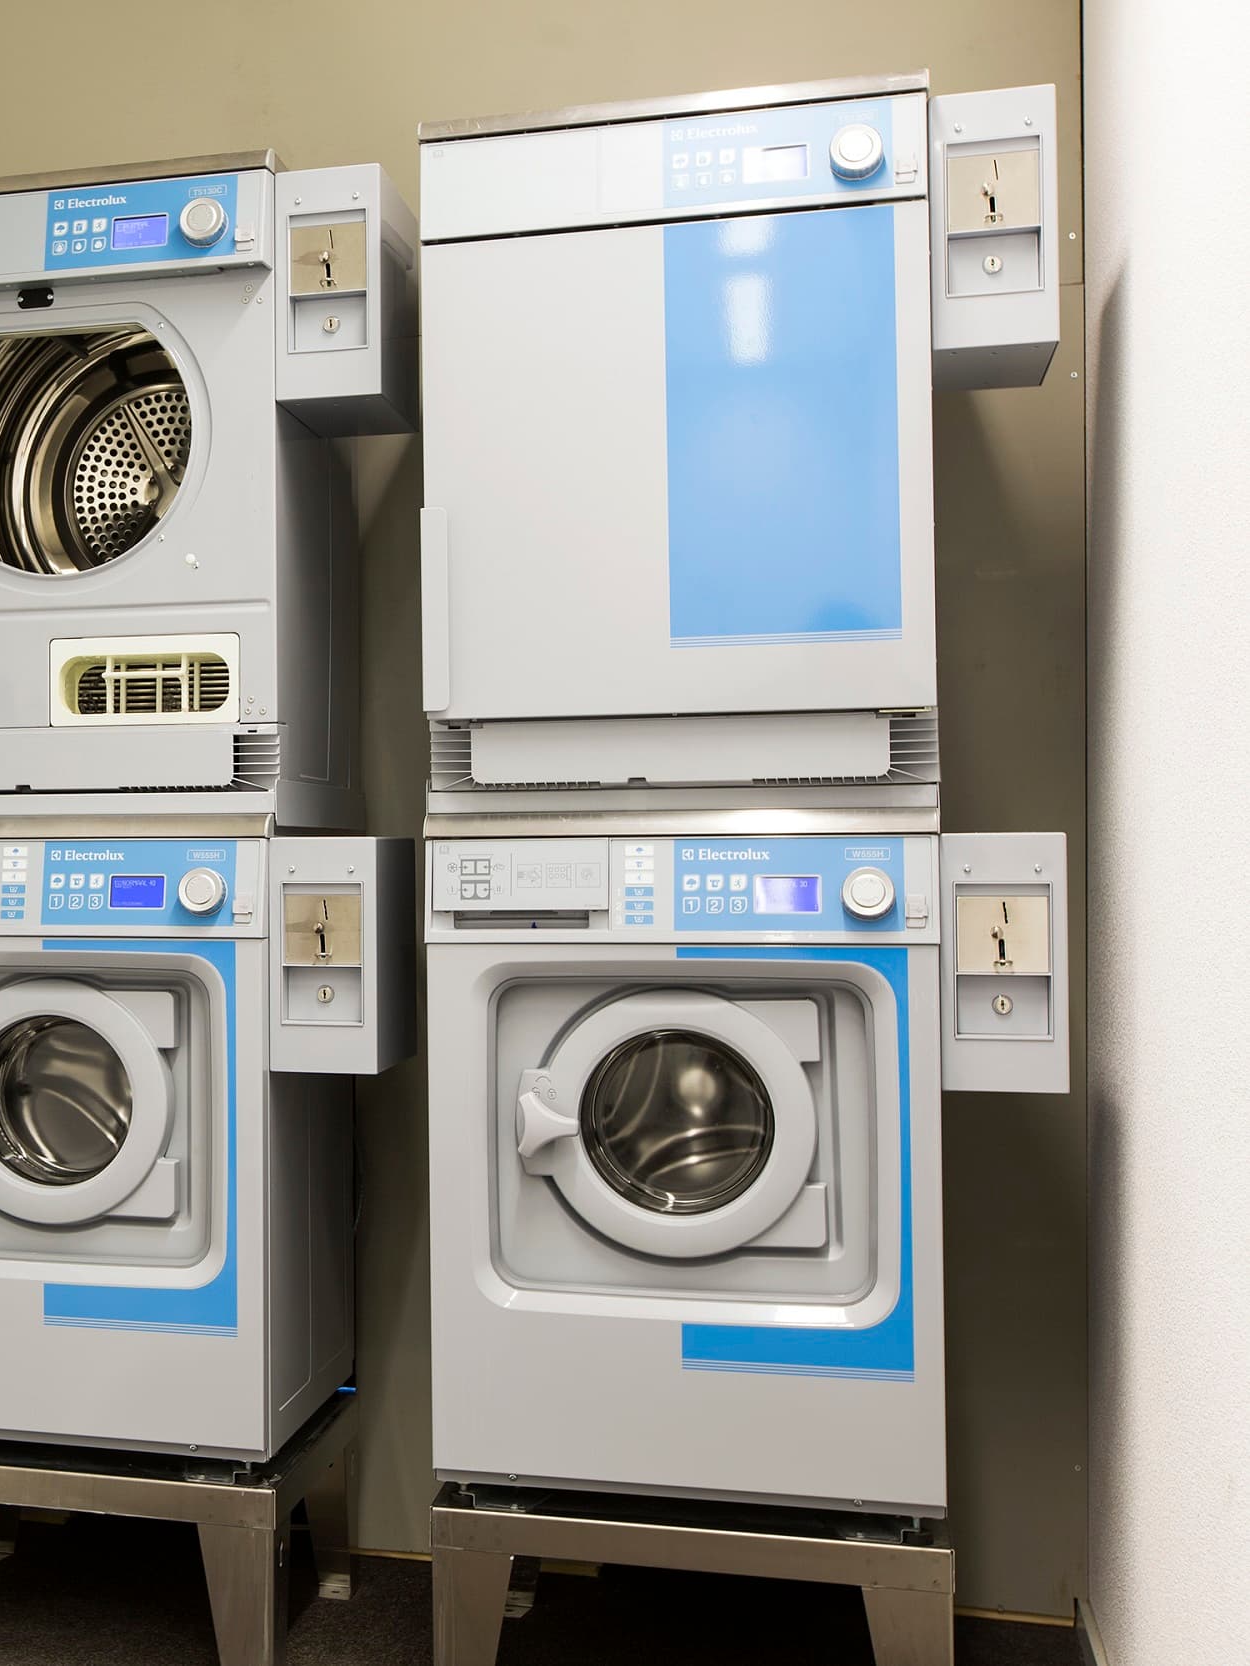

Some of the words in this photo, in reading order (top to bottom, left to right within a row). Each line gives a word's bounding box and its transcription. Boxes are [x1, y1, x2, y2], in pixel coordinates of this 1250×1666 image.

[686, 124, 758, 140] Electrolux
[68, 195, 127, 209] Electrolux
[65, 849, 125, 861] Electrolux
[699, 848, 769, 861] Electrolux
[53, 897, 59, 907] 1
[73, 897, 80, 907] 2
[92, 897, 99, 907] 3
[688, 900, 694, 911] 1
[710, 900, 719, 911] 2
[733, 900, 742, 911] 3
